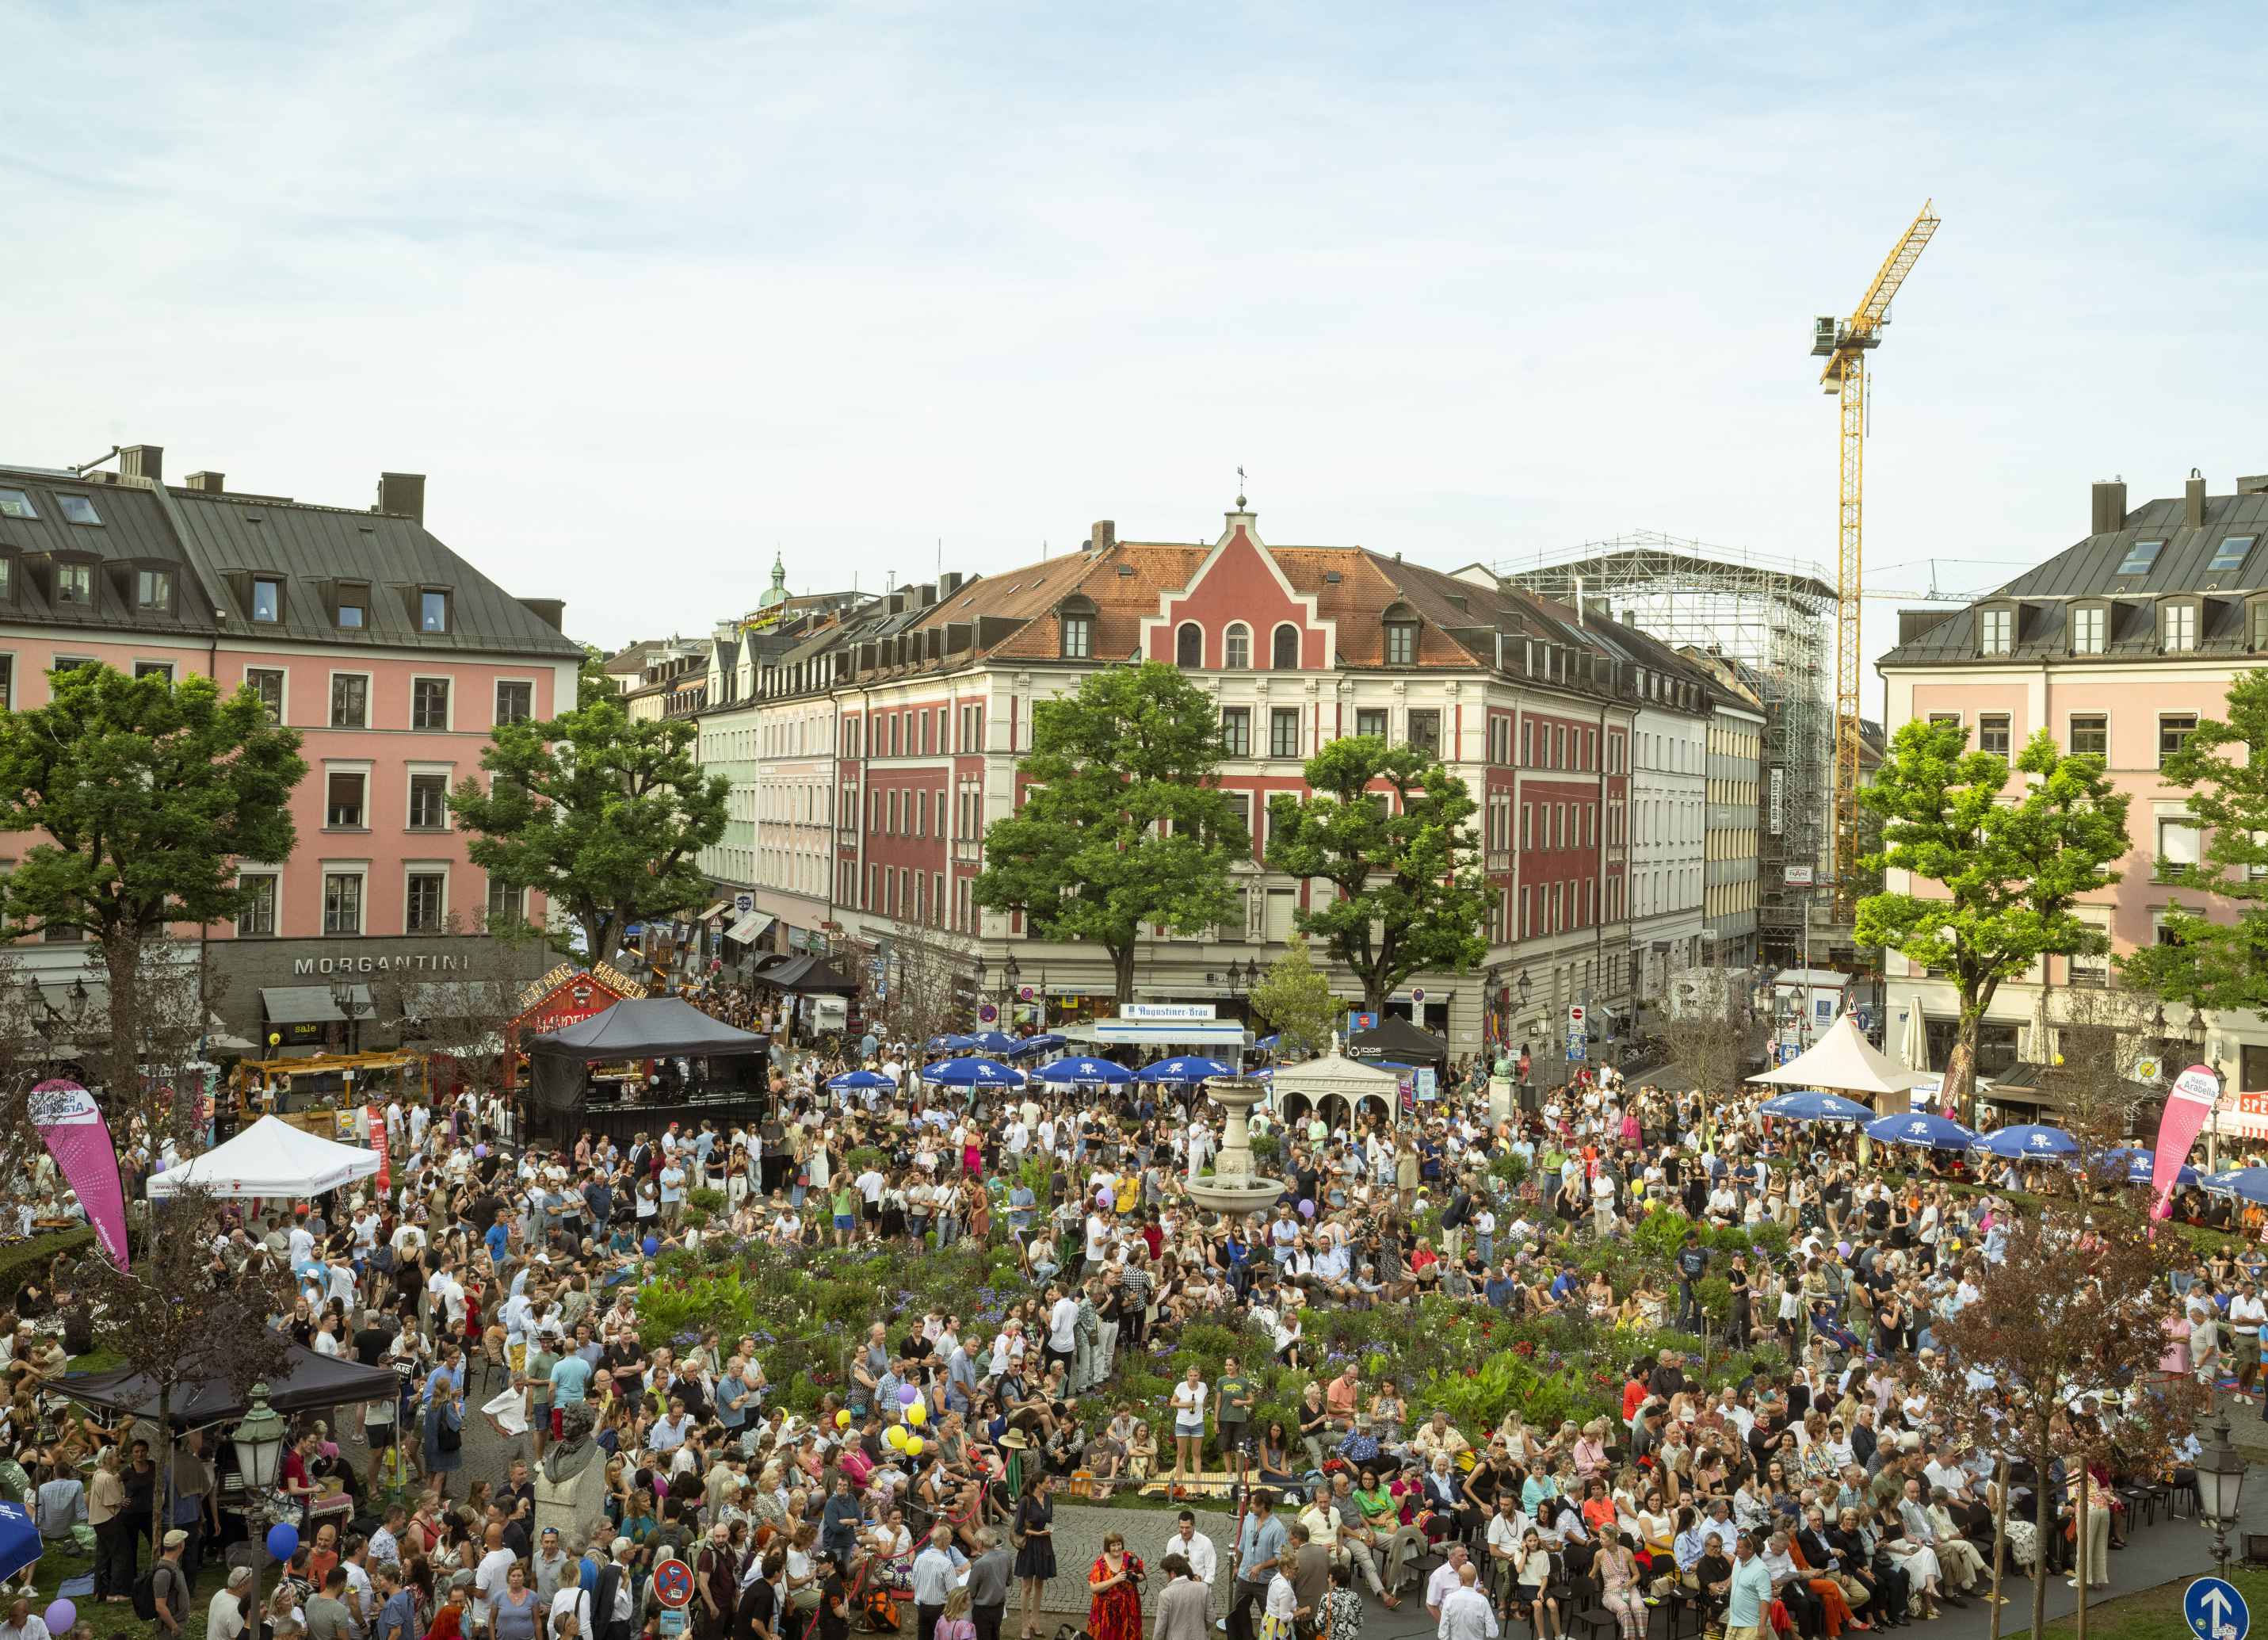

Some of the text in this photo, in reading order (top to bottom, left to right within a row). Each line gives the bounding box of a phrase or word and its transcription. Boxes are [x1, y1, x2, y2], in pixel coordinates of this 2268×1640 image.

[294, 955, 468, 975] MORGANTINI
[295, 1024, 317, 1033] sale
[2190, 1076, 2207, 1087] Radio
[2184, 1080, 2216, 1098] Arabella
